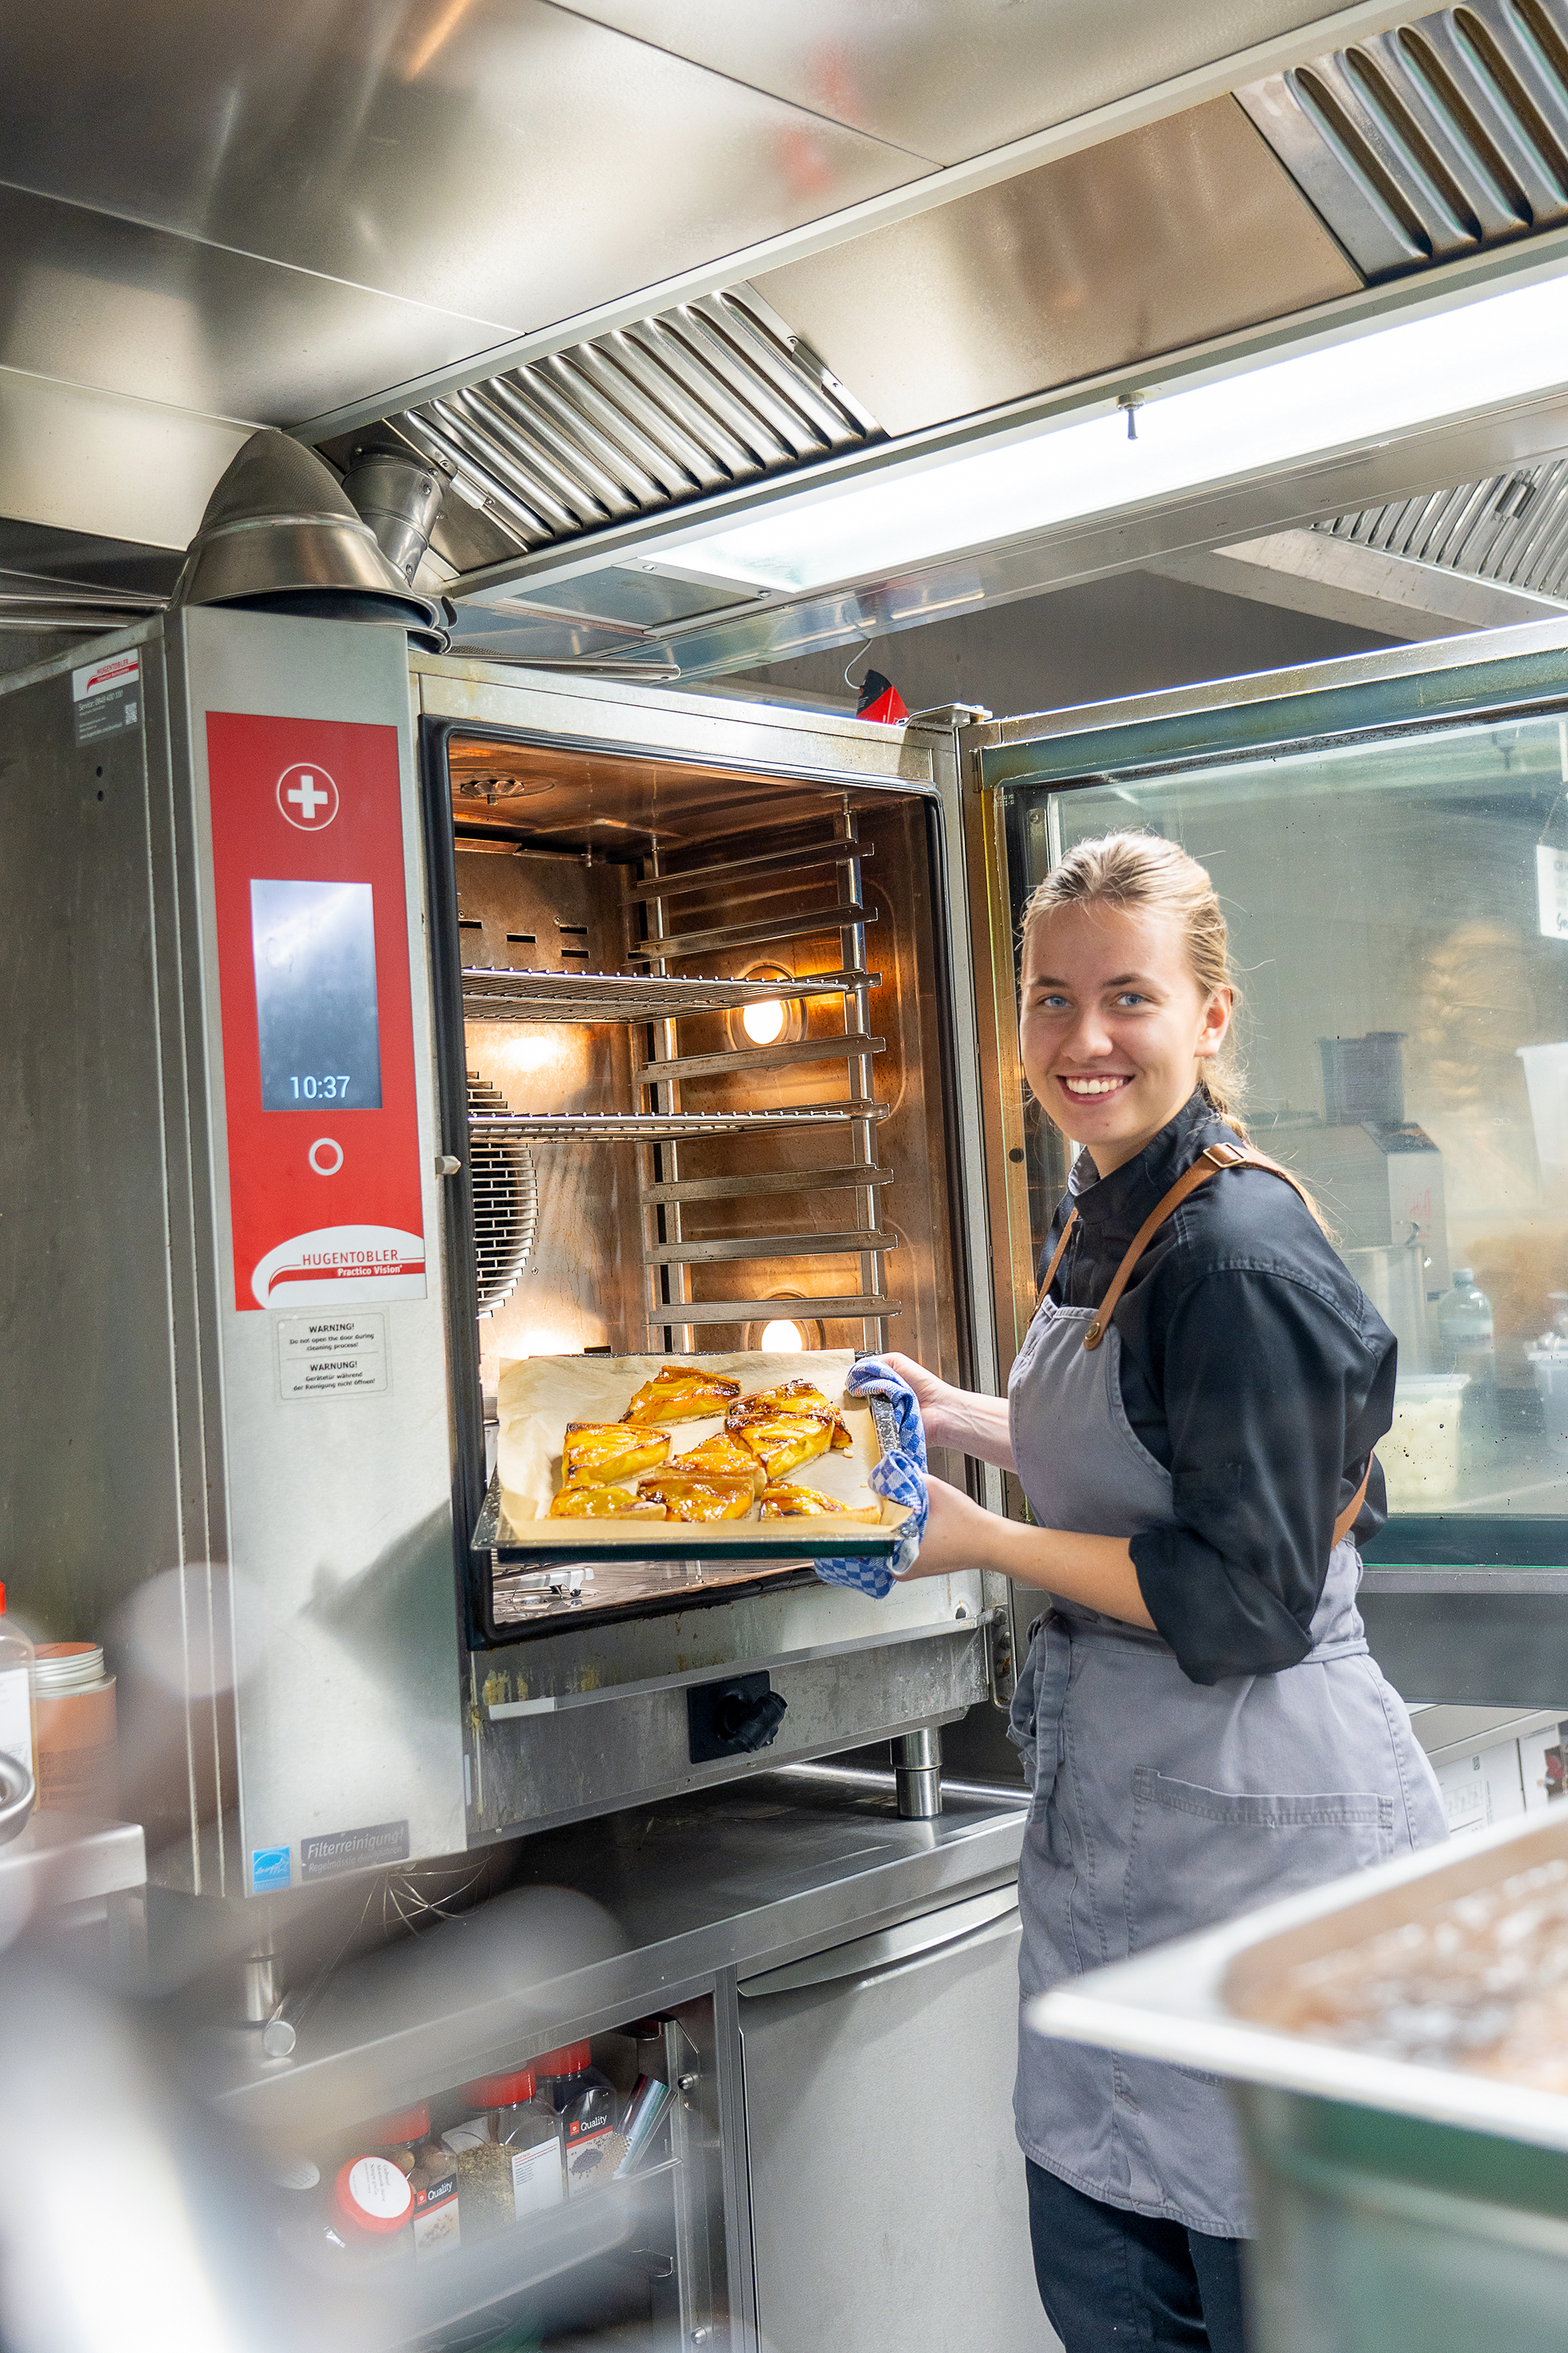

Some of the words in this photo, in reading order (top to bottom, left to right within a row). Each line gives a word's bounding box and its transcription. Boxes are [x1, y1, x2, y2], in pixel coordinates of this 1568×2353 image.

[290, 1075, 351, 1099] 10:37
[303, 1249, 398, 1265] HUGENTOBLER
[338, 1267, 372, 1277] Practico
[309, 1323, 355, 1333] WARNING!
[310, 1361, 358, 1371] WARNUNG!
[308, 1827, 405, 1859] Filterreinigung!
[580, 2115, 607, 2131] Quality
[428, 2181, 453, 2201] Quality
